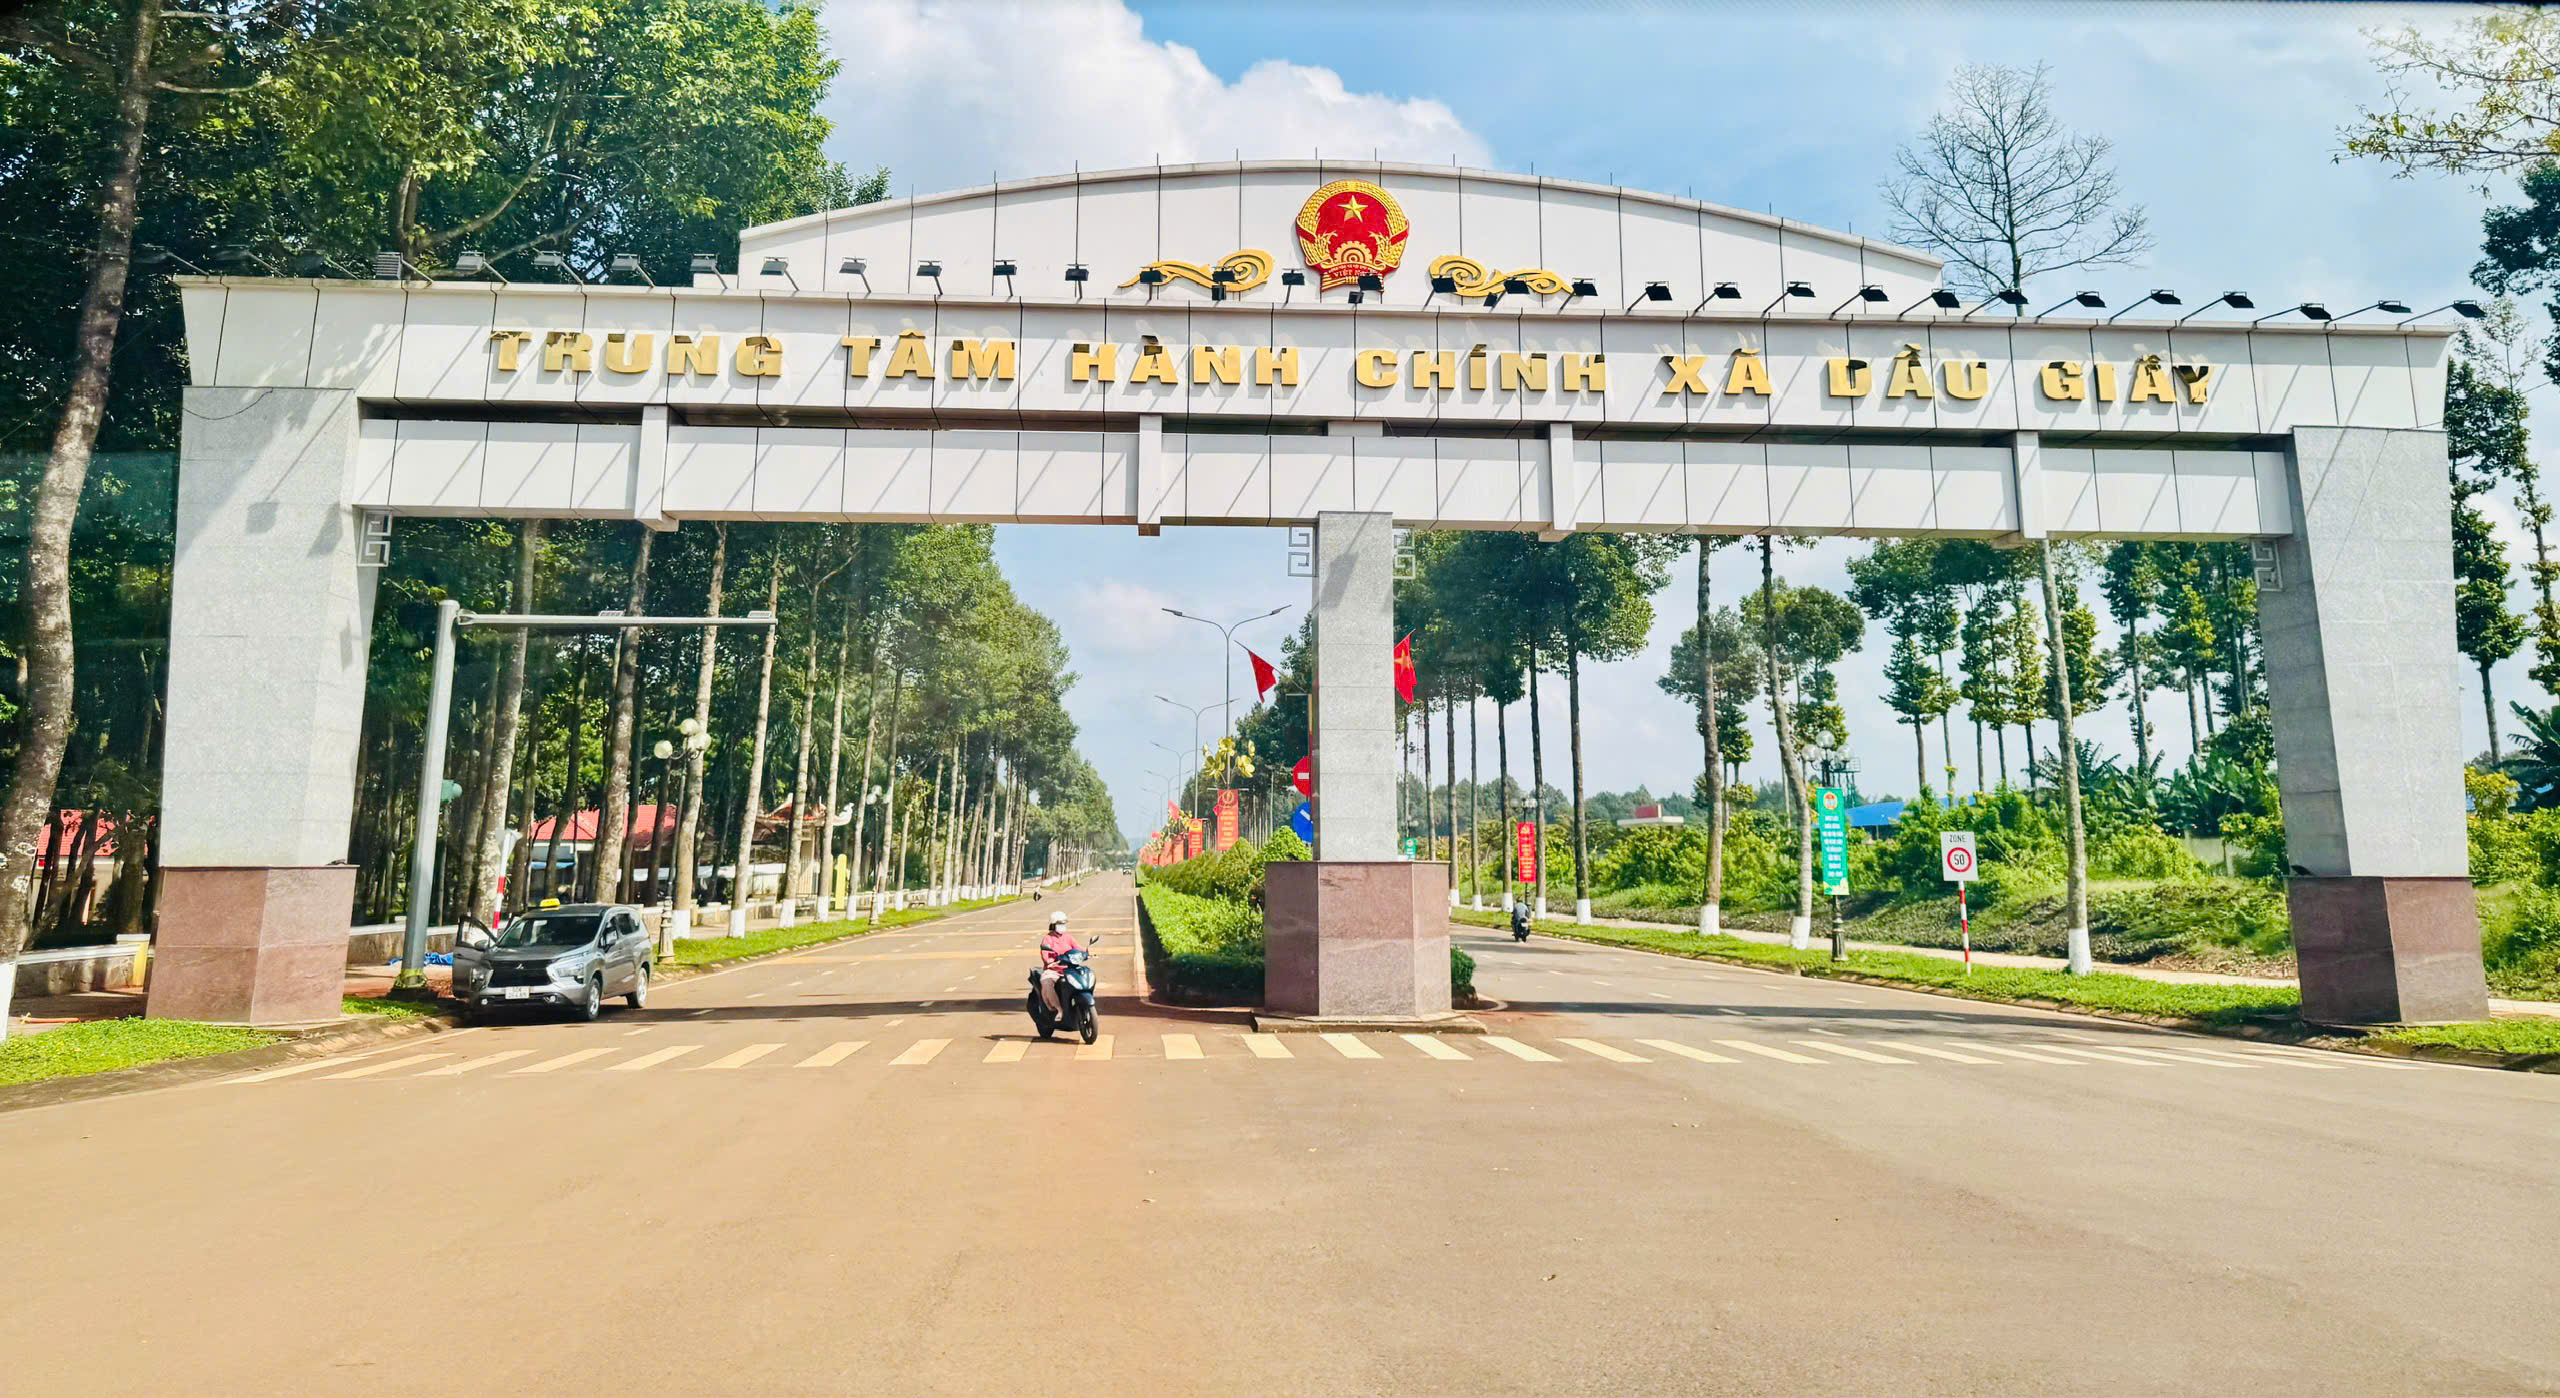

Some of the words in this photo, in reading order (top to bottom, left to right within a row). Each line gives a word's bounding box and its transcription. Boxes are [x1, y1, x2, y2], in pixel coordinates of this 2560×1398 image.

[489, 331, 783, 377] TRUNG
[842, 328, 1015, 380] TÂM
[1072, 335, 1298, 385] HÀNH
[1356, 344, 1606, 392] CHÍNH
[1661, 348, 1773, 395] XÃ
[1827, 343, 1988, 400] DẦU
[1949, 834, 1967, 843] ZONE
[1954, 854, 1965, 866] 50
